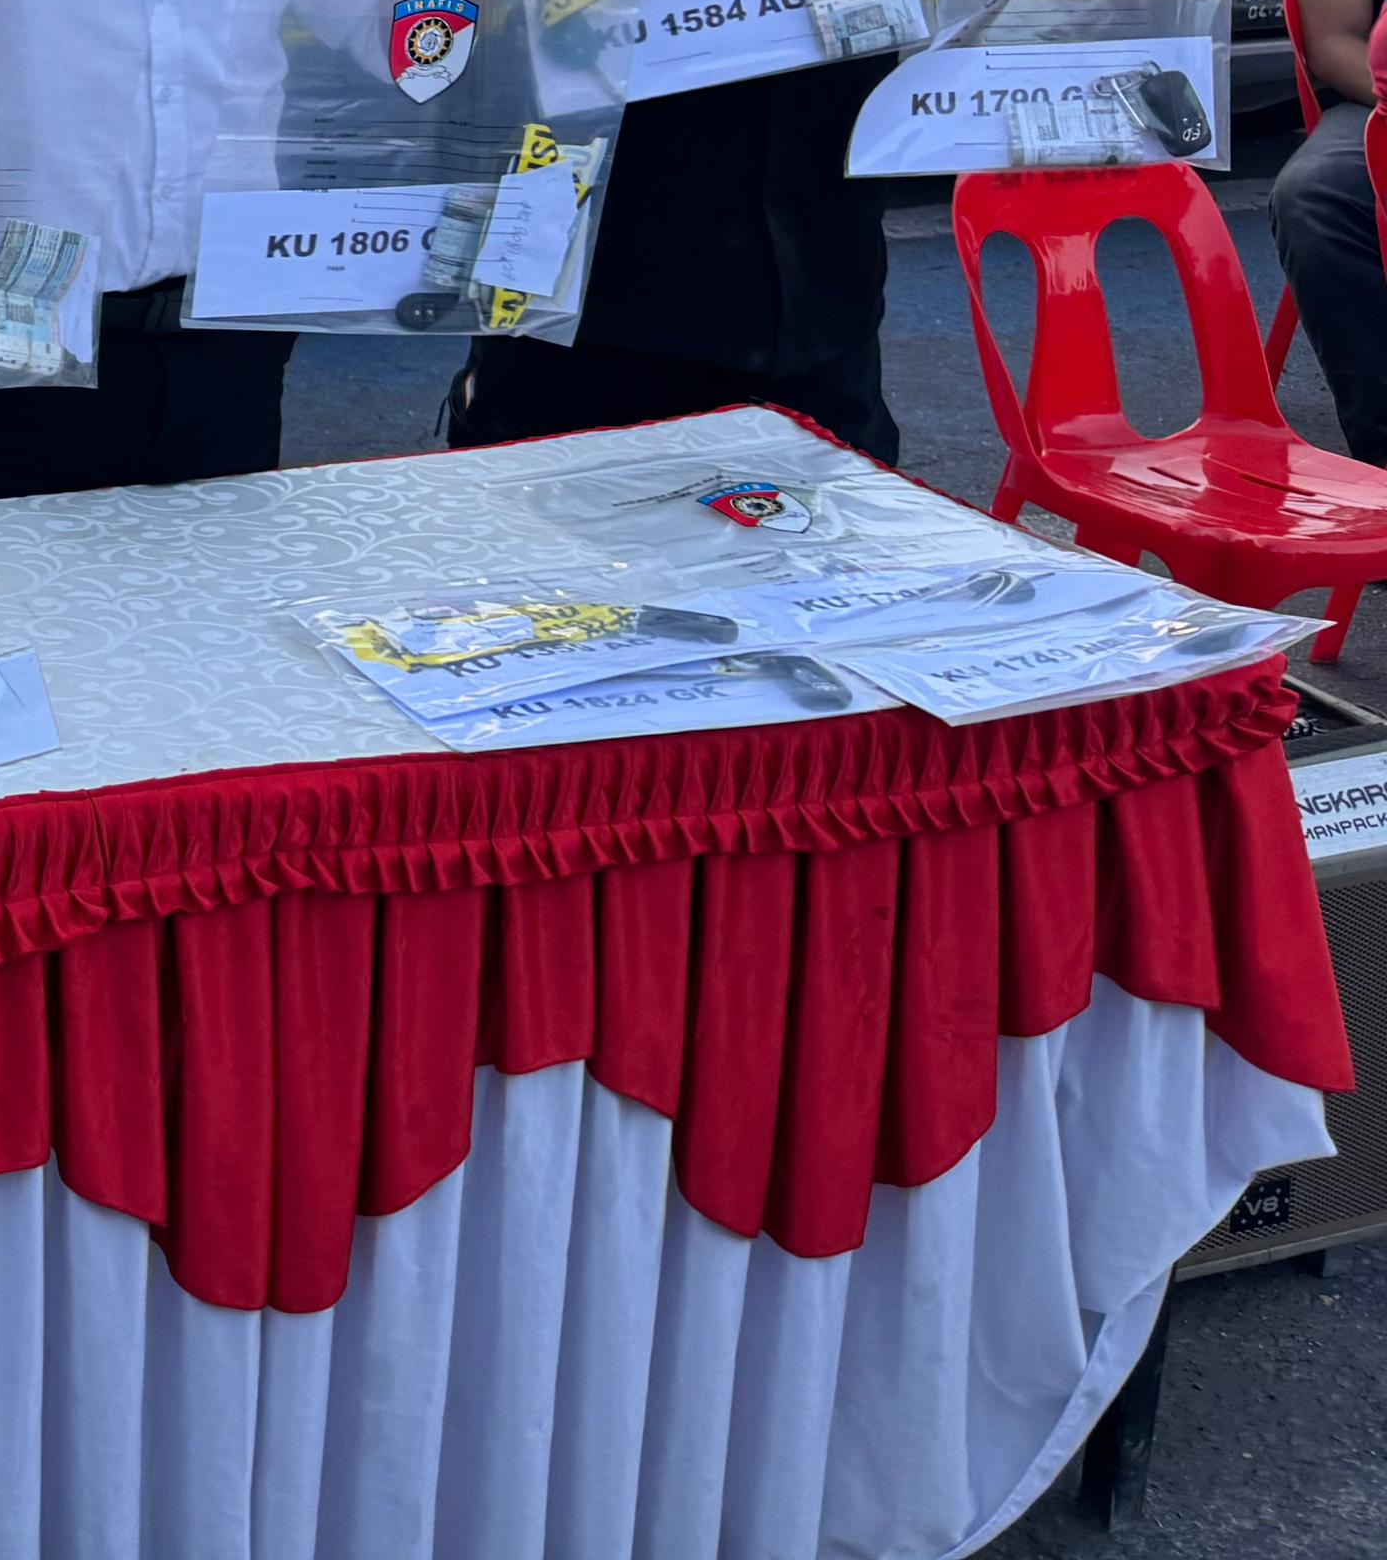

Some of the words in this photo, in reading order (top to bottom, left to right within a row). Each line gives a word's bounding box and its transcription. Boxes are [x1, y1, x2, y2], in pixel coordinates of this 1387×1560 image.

[911, 92, 956, 116] KU
[266, 232, 318, 259] KU
[330, 228, 410, 256] 1806
[792, 594, 850, 612] KU
[444, 651, 502, 678] KU
[993, 648, 1078, 672] 1749
[489, 700, 553, 720] KU
[562, 689, 658, 712] 1824
[665, 680, 730, 701] GK
[1245, 1193, 1280, 1218] V8
